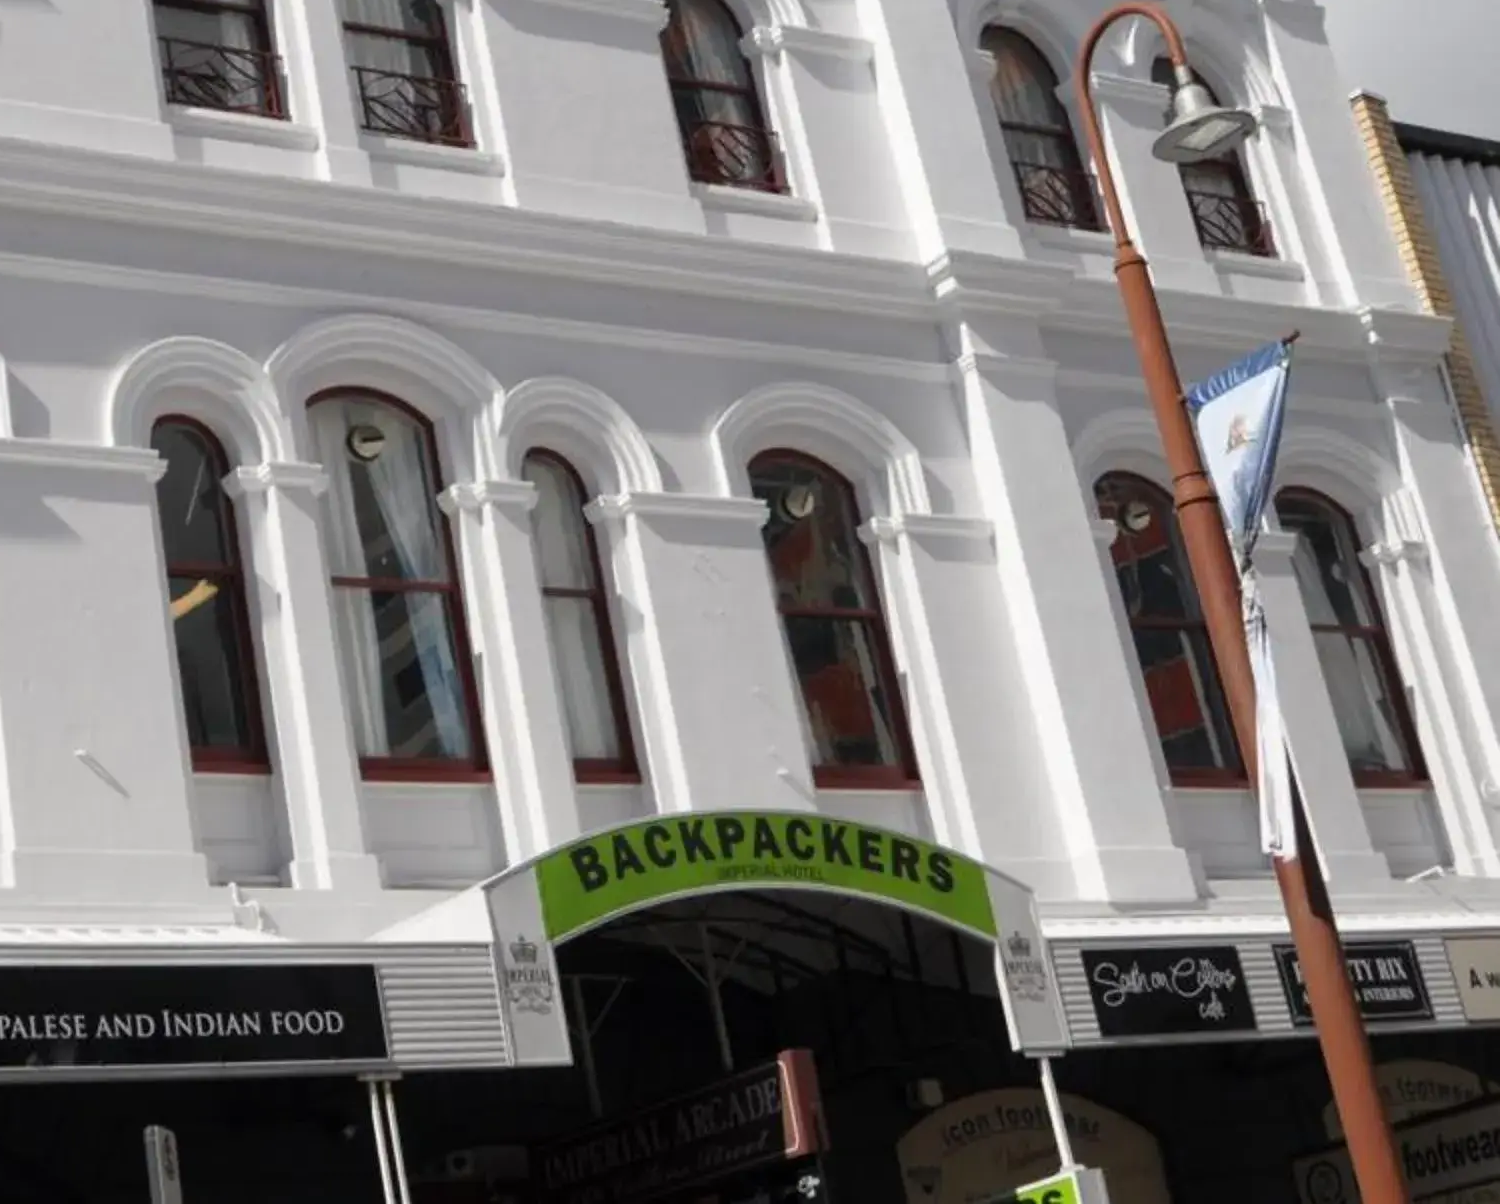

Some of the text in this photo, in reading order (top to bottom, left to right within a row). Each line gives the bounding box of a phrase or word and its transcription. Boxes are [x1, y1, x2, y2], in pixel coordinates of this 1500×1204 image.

[569, 817, 956, 893] BACKPACKERS
[95, 1013, 156, 1038] AND
[270, 1009, 344, 1035] FOOD
